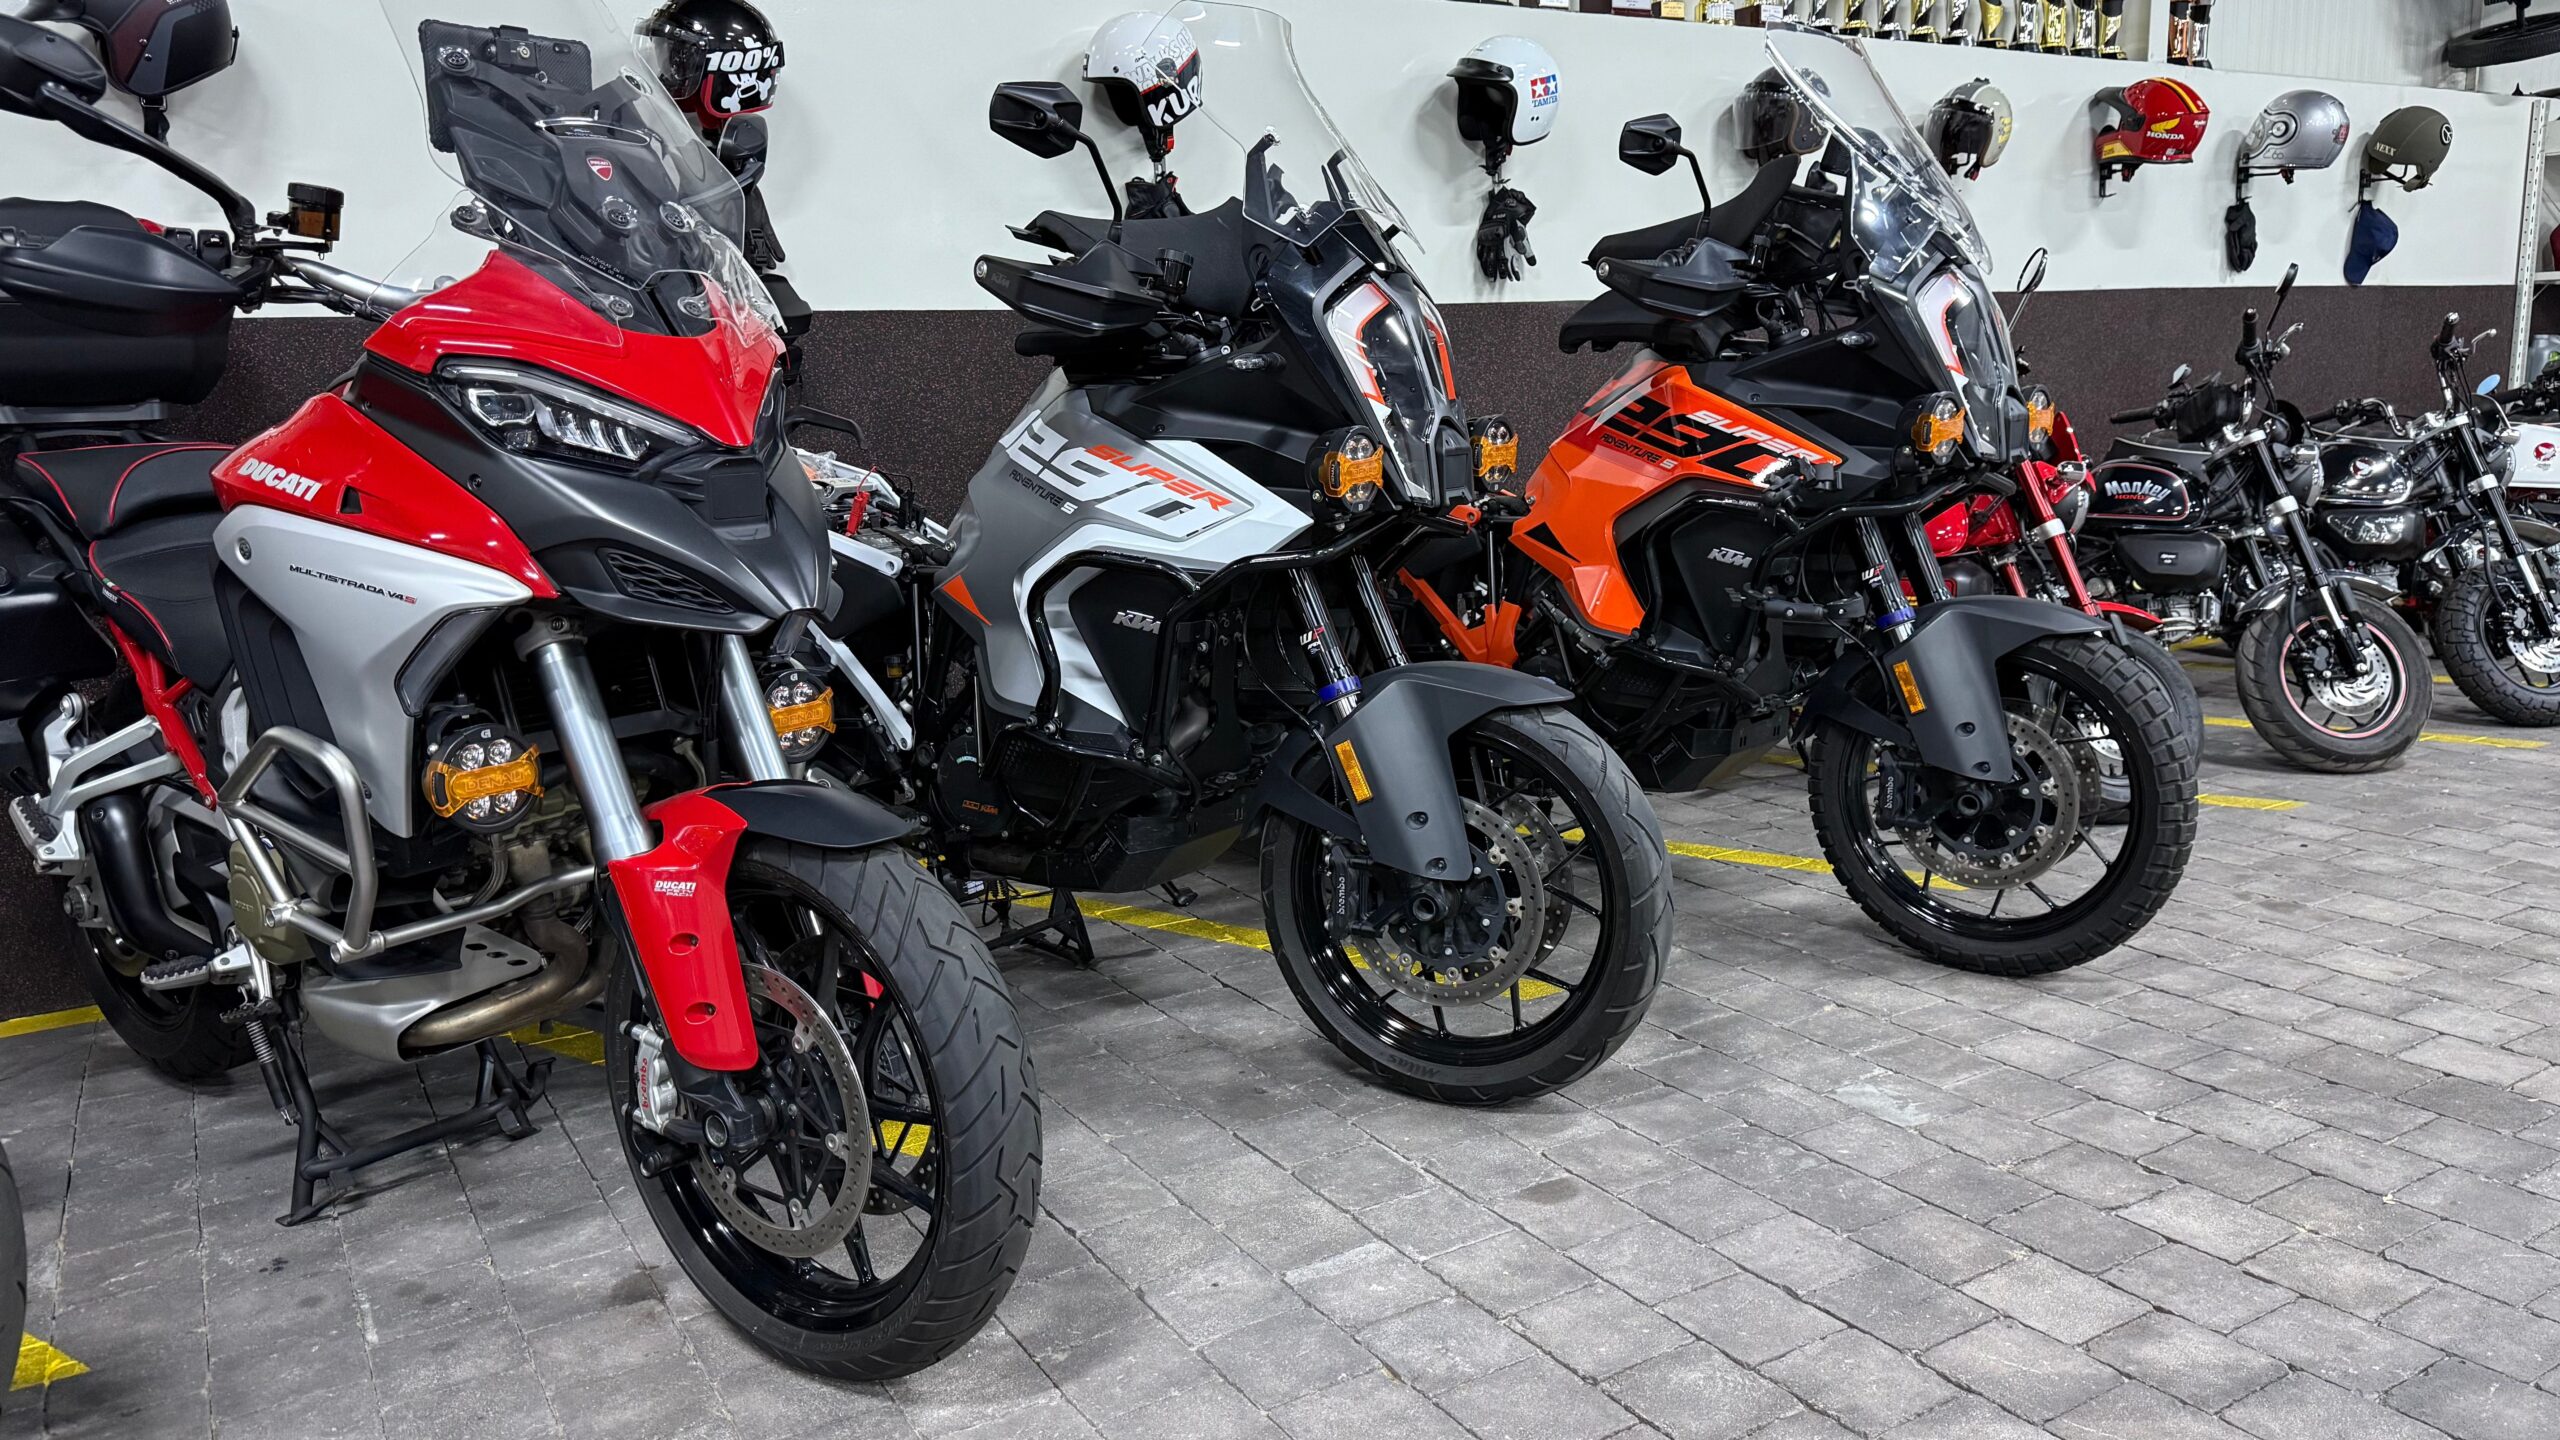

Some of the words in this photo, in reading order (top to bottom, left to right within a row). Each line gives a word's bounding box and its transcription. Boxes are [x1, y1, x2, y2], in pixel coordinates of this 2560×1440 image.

[706, 46, 779, 72] 100%
[2146, 131, 2185, 140] HONDA
[2374, 141, 2397, 157] NEXX
[1686, 410, 1824, 462] SUPER
[1601, 433, 1662, 464] ADVENTURE
[1659, 458, 1679, 470] S
[238, 458, 323, 502] DUCATI
[1009, 468, 1064, 507] ADVENTURE
[1061, 501, 1078, 515] S
[1085, 444, 1233, 512] SUPER
[2104, 480, 2172, 502] Monkey
[1707, 547, 1752, 568] KTM
[289, 564, 385, 596] MULTISTRADA
[388, 591, 417, 605] V4S
[1112, 610, 1161, 635] KTM
[780, 707, 824, 725] DENALI
[464, 767, 530, 792] DENALI
[1884, 776, 1894, 809] brembo
[655, 880, 697, 890] DUCATI
[1336, 876, 1345, 915] brembo
[640, 1058, 649, 1109] brembo
